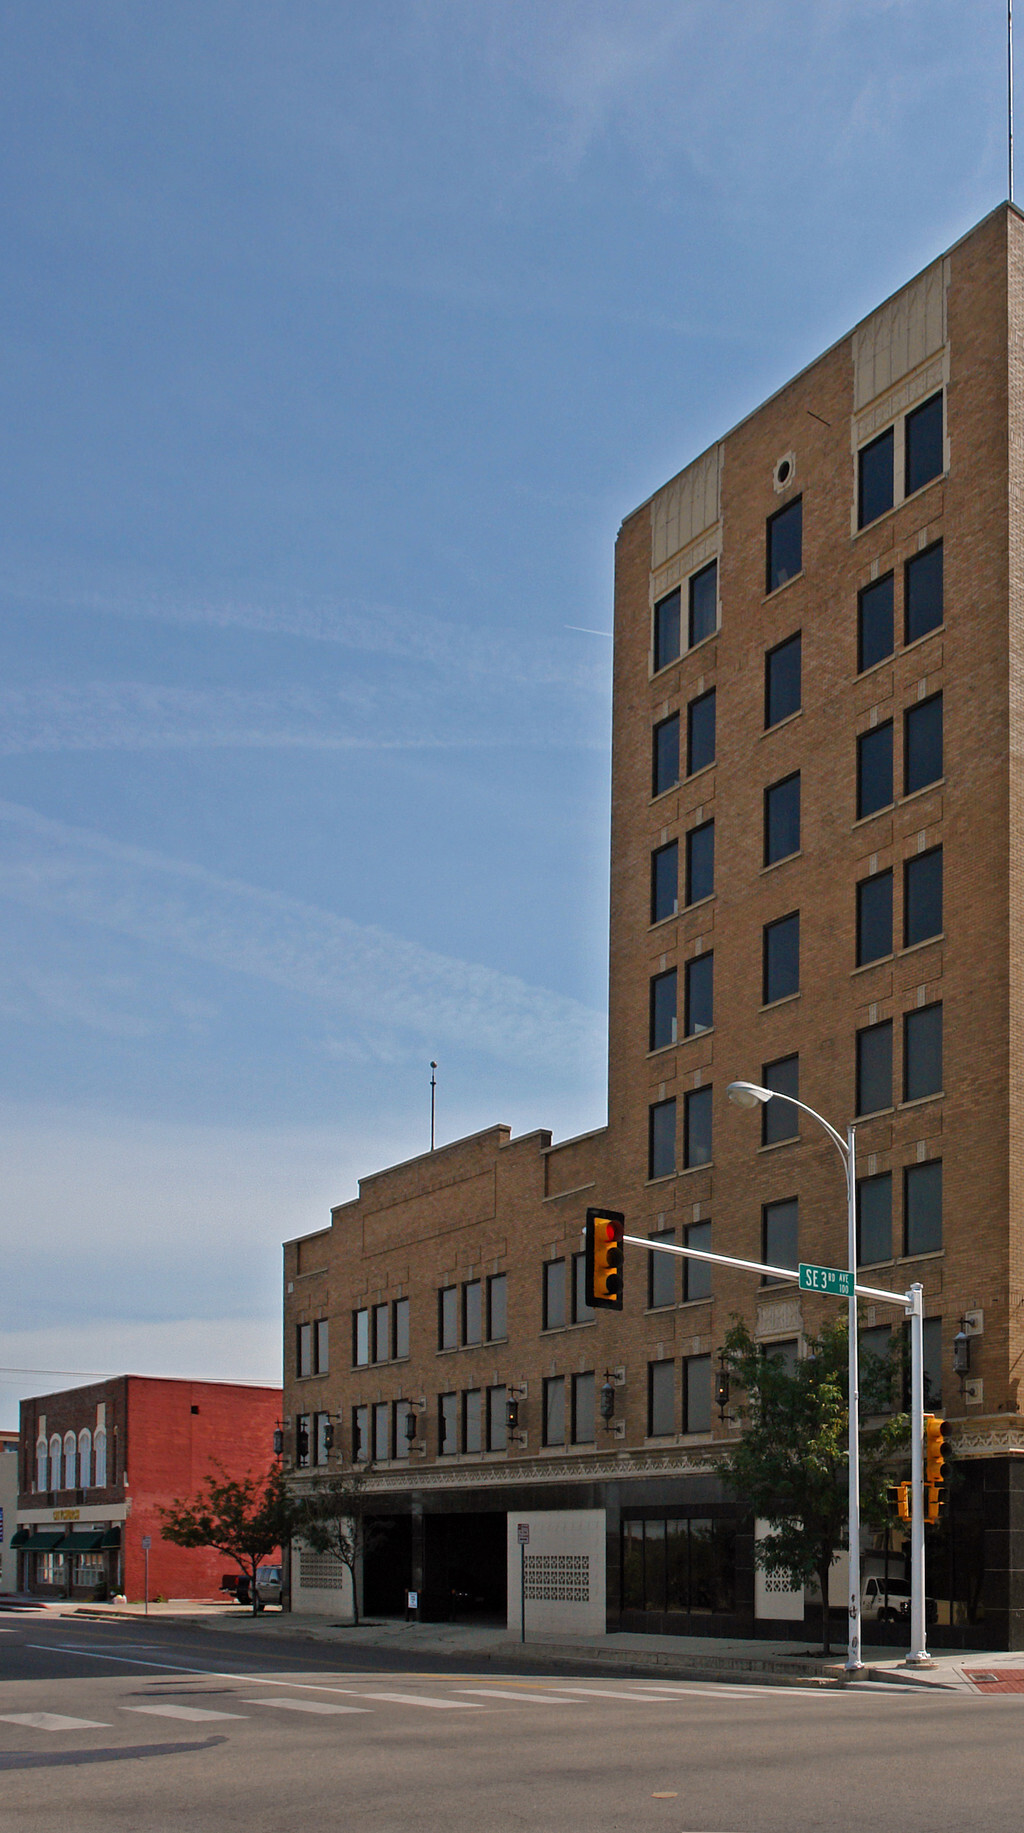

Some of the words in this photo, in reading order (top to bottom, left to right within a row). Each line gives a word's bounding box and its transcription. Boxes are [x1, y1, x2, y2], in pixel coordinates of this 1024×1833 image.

[805, 1268, 819, 1288] SE
[820, 1271, 836, 1289] 3RD
[839, 1284, 849, 1294] 100
